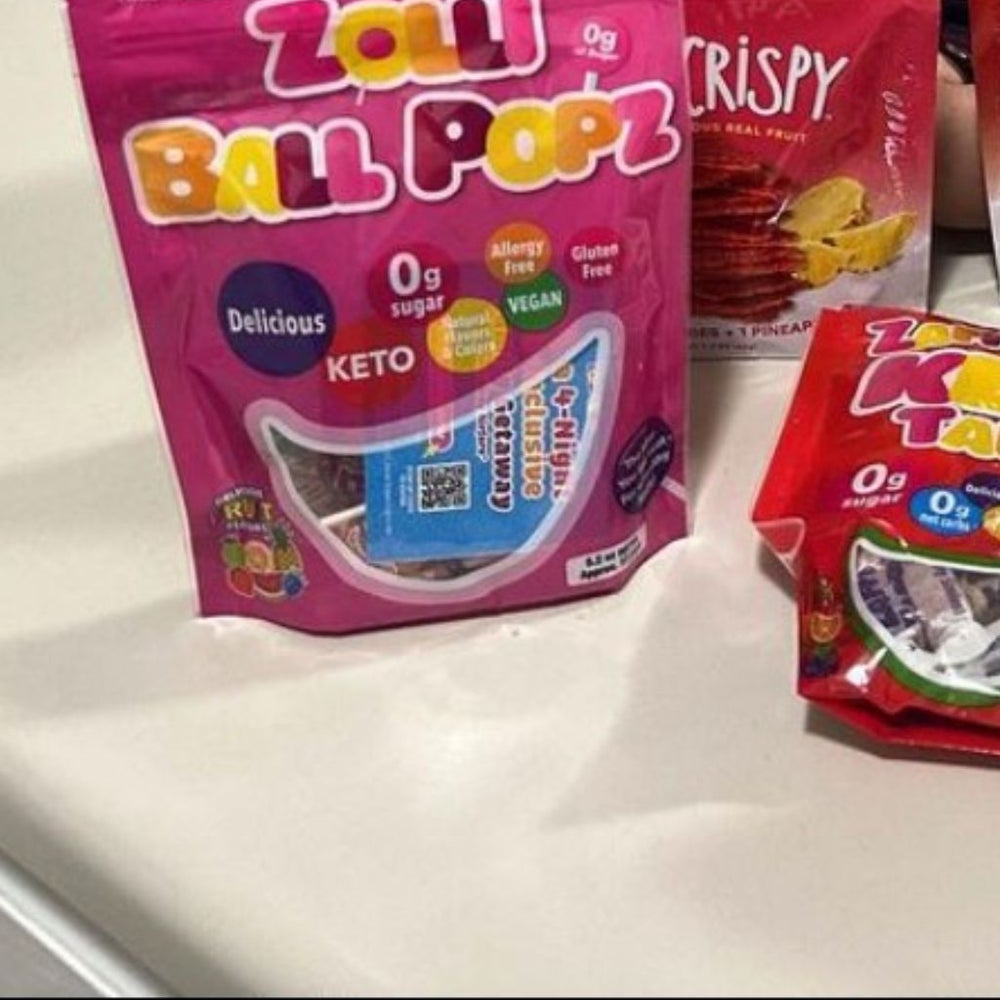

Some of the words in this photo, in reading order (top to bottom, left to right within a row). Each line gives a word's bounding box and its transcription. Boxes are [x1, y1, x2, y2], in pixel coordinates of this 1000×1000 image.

[123, 116, 397, 226] BALL
[403, 80, 681, 201] POPZ
[490, 240, 545, 259] Allergy
[570, 243, 620, 263] Gluten
[388, 252, 441, 296] 0g
[504, 260, 536, 276] Free
[582, 263, 613, 280] Free
[390, 295, 445, 319] sugar
[506, 290, 563, 314] VEGAN
[227, 307, 327, 335] Delicious
[752, 319, 814, 338] PINEAP
[327, 345, 416, 383] KETO
[521, 384, 548, 498] clusive
[852, 463, 908, 495] 0g
[841, 493, 904, 510] sugar
[929, 490, 971, 519] 0g
